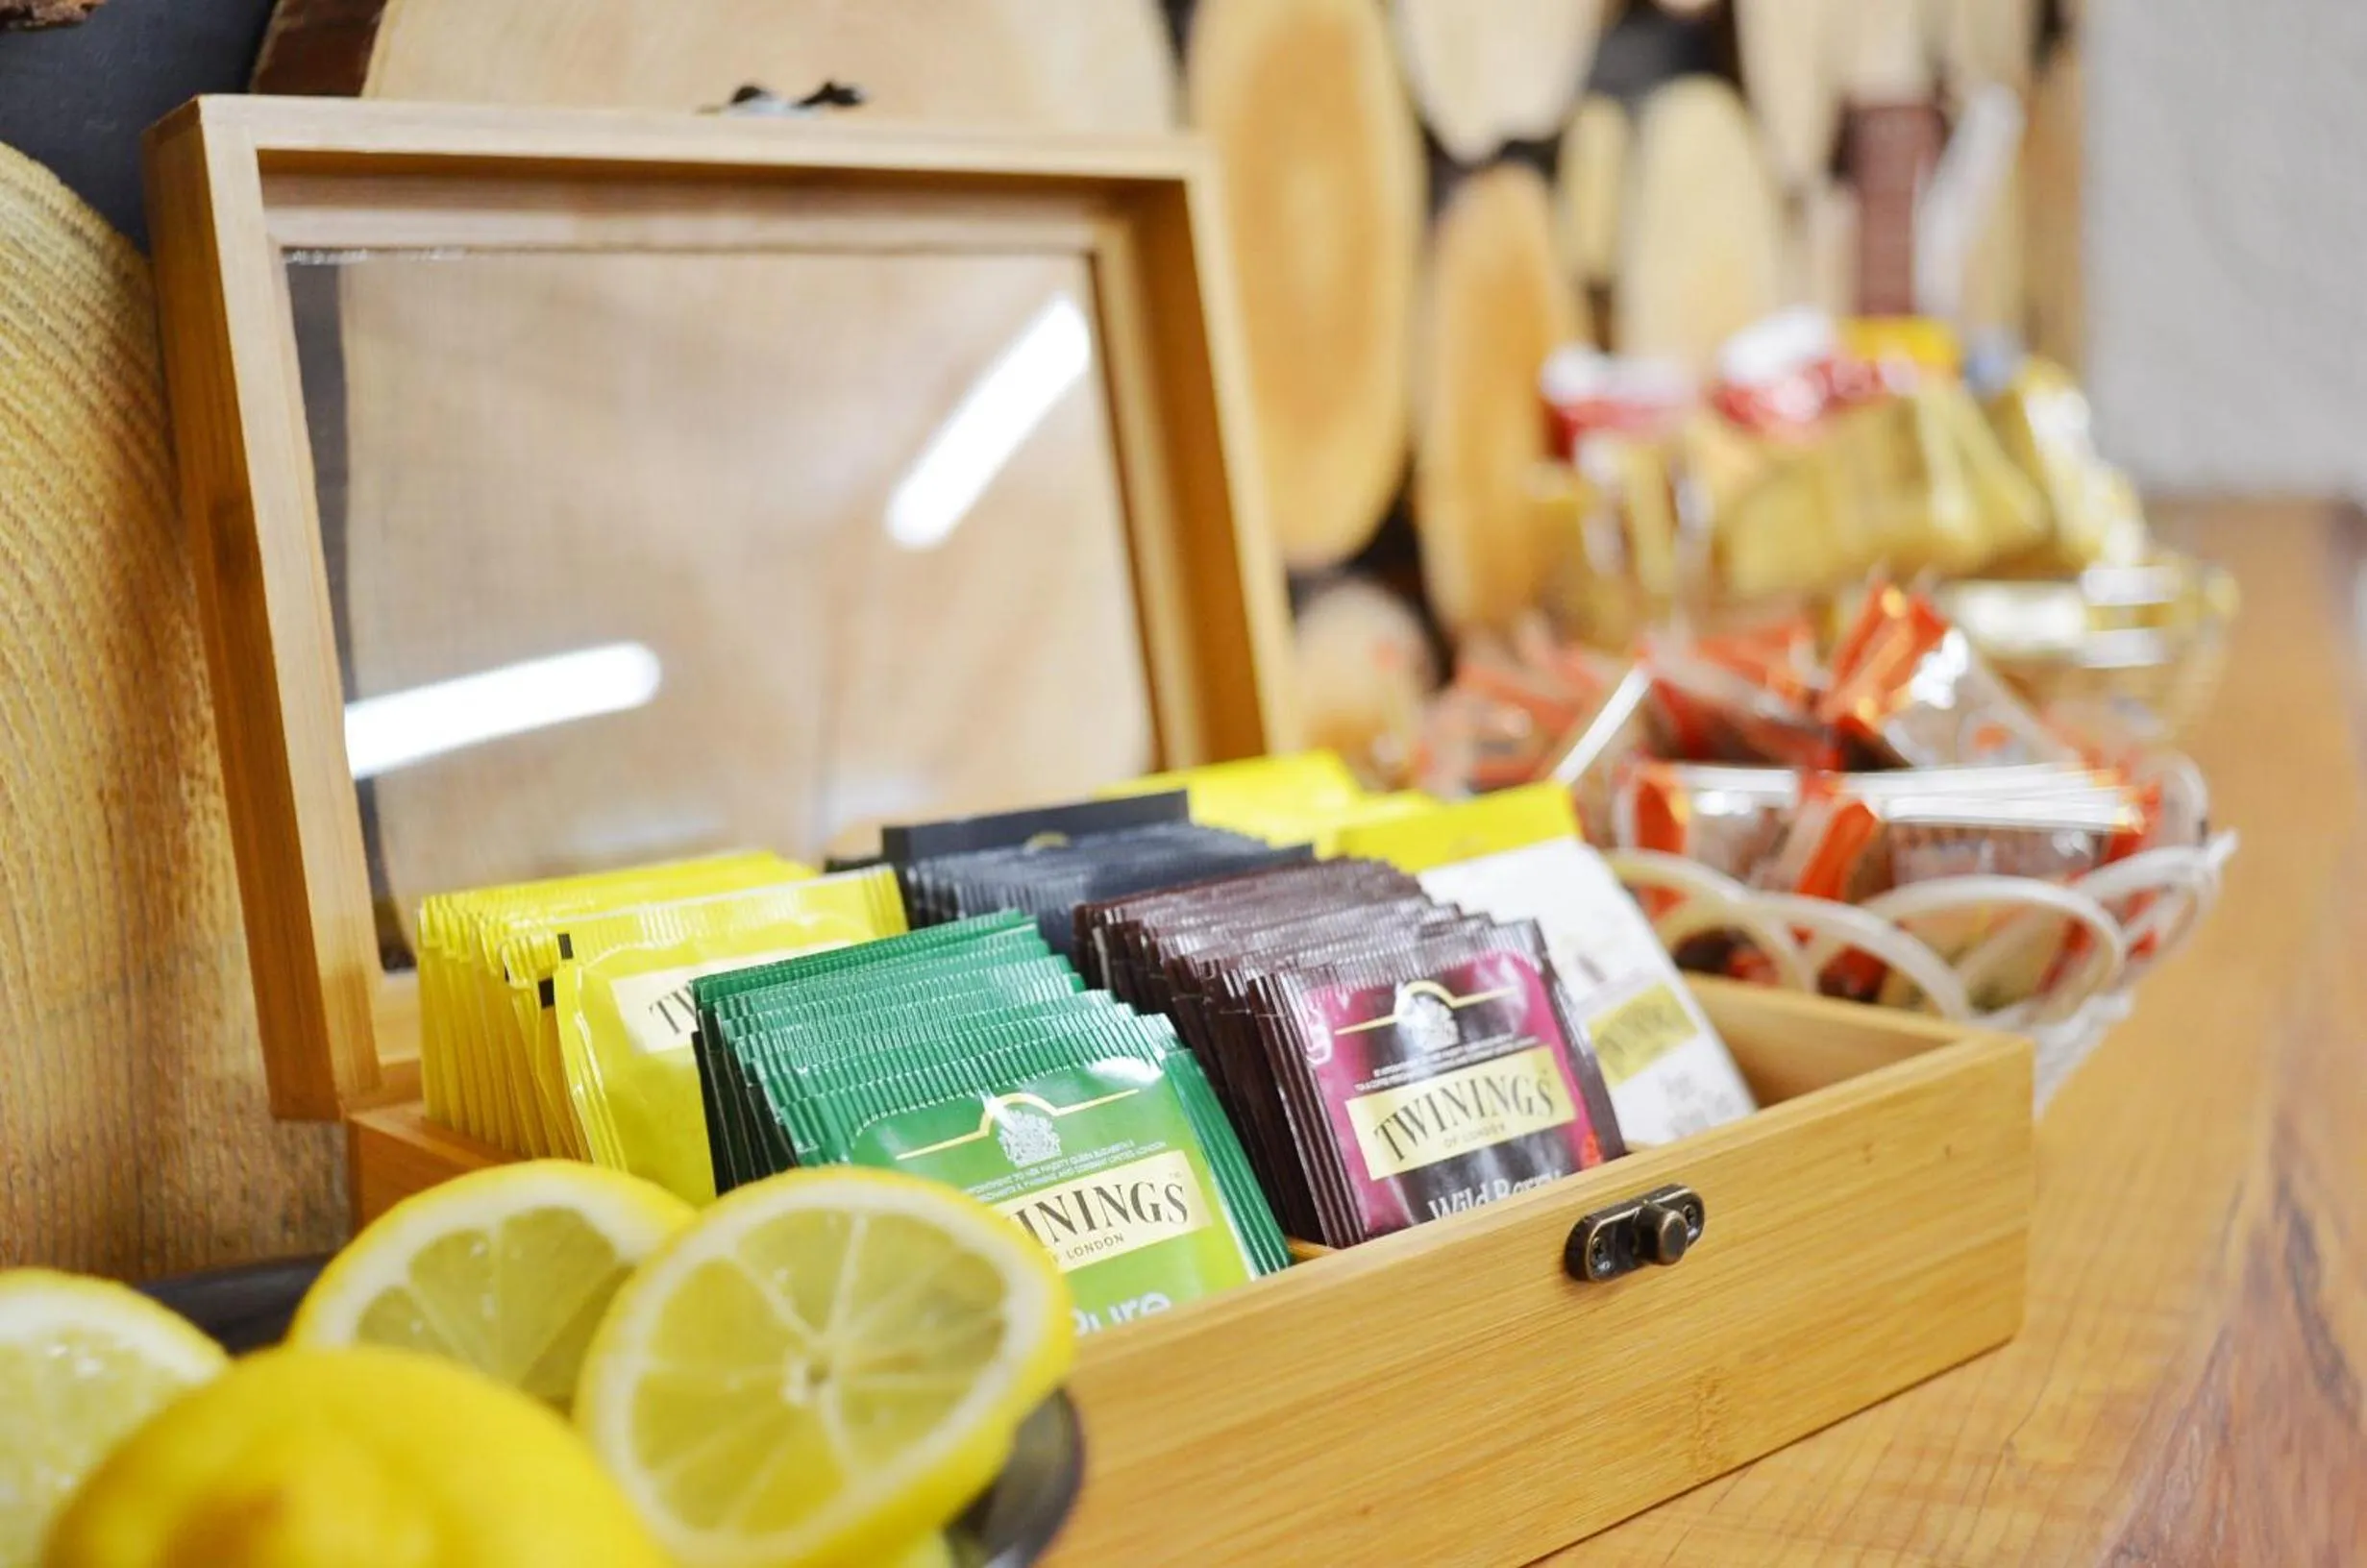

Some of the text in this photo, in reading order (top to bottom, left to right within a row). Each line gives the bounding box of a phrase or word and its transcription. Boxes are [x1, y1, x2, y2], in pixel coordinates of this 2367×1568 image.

[1373, 1074, 1555, 1162] TWININGS
[1012, 1181, 1189, 1245] ININGS
[1428, 1168, 1564, 1219] Wild Ber
[1066, 1233, 1124, 1260] LONDON
